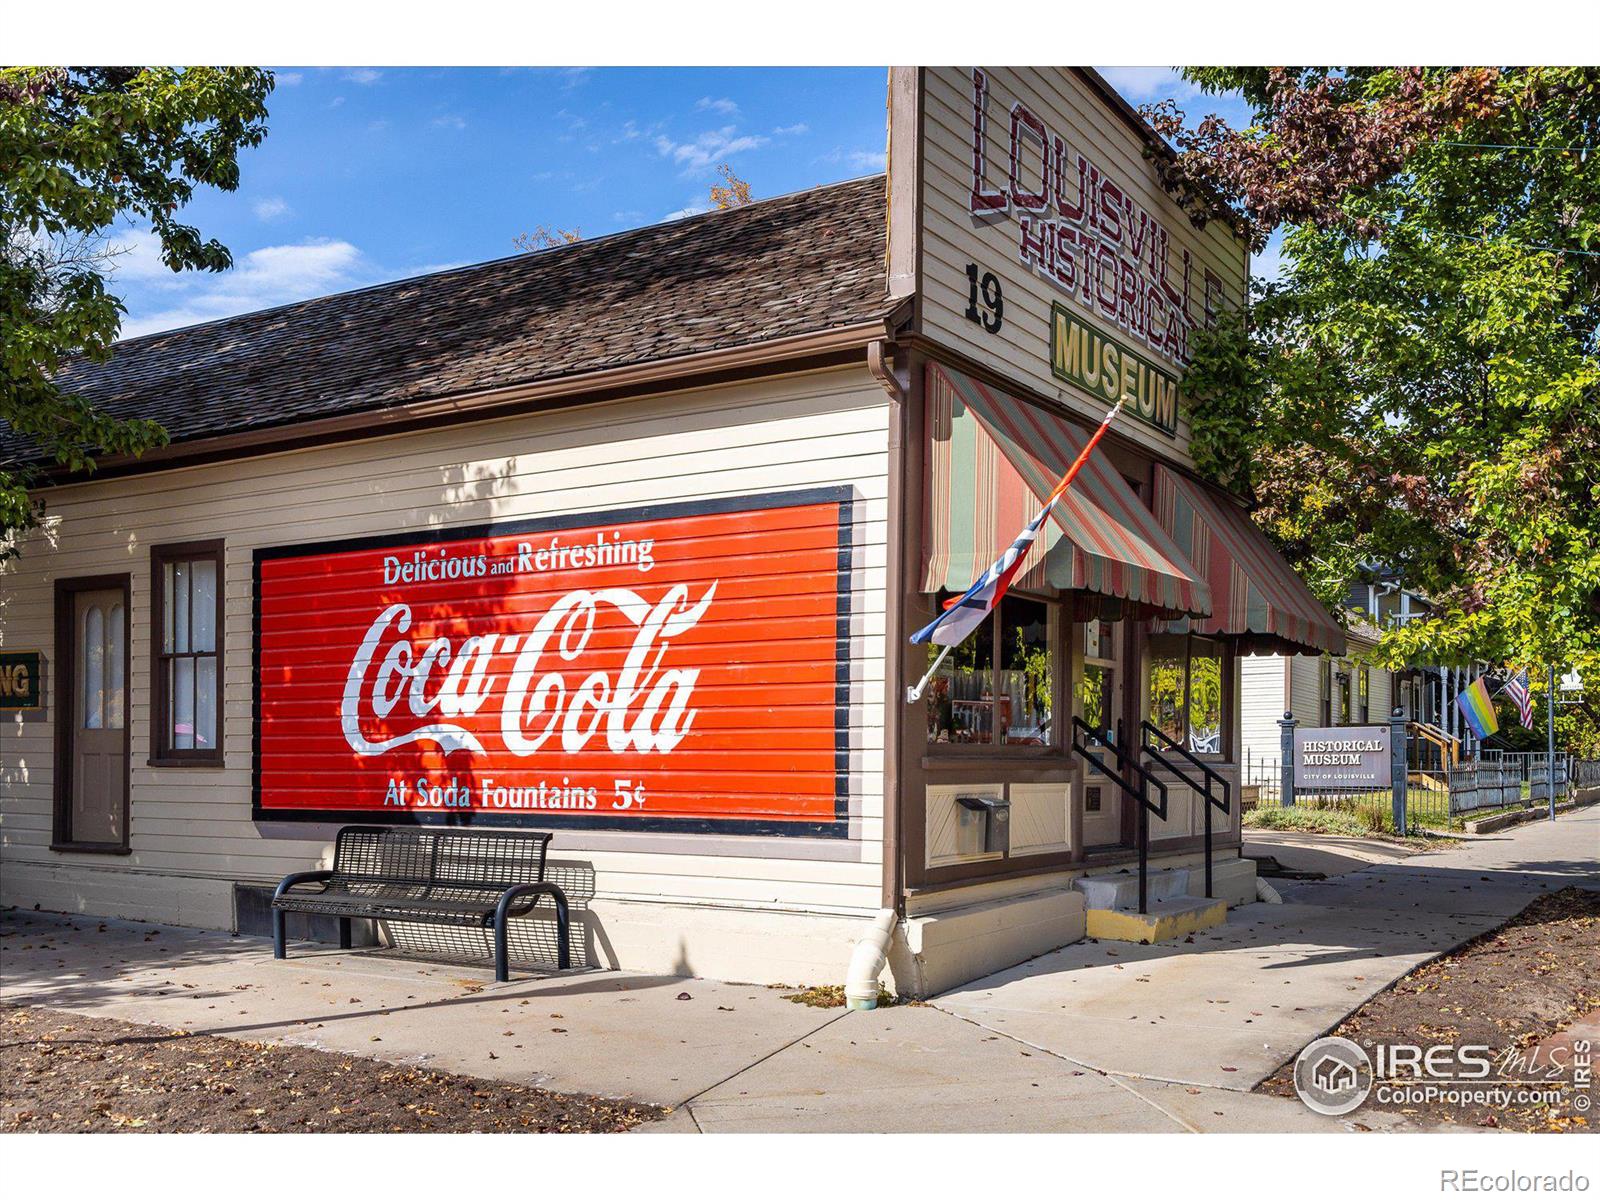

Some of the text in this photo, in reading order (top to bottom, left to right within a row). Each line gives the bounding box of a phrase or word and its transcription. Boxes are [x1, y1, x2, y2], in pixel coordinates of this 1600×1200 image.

[965, 263, 1003, 334] 19
[1019, 216, 1192, 368] HISTORICAL
[1055, 312, 1176, 428] MUSEUM
[384, 531, 655, 585] Delicious and Refreshing
[341, 579, 718, 757] Coca-Cola
[1303, 740, 1383, 752] HISTORICAL
[1303, 754, 1361, 765] MUSEUM
[384, 776, 646, 810] At Soda Fountains 5¢
